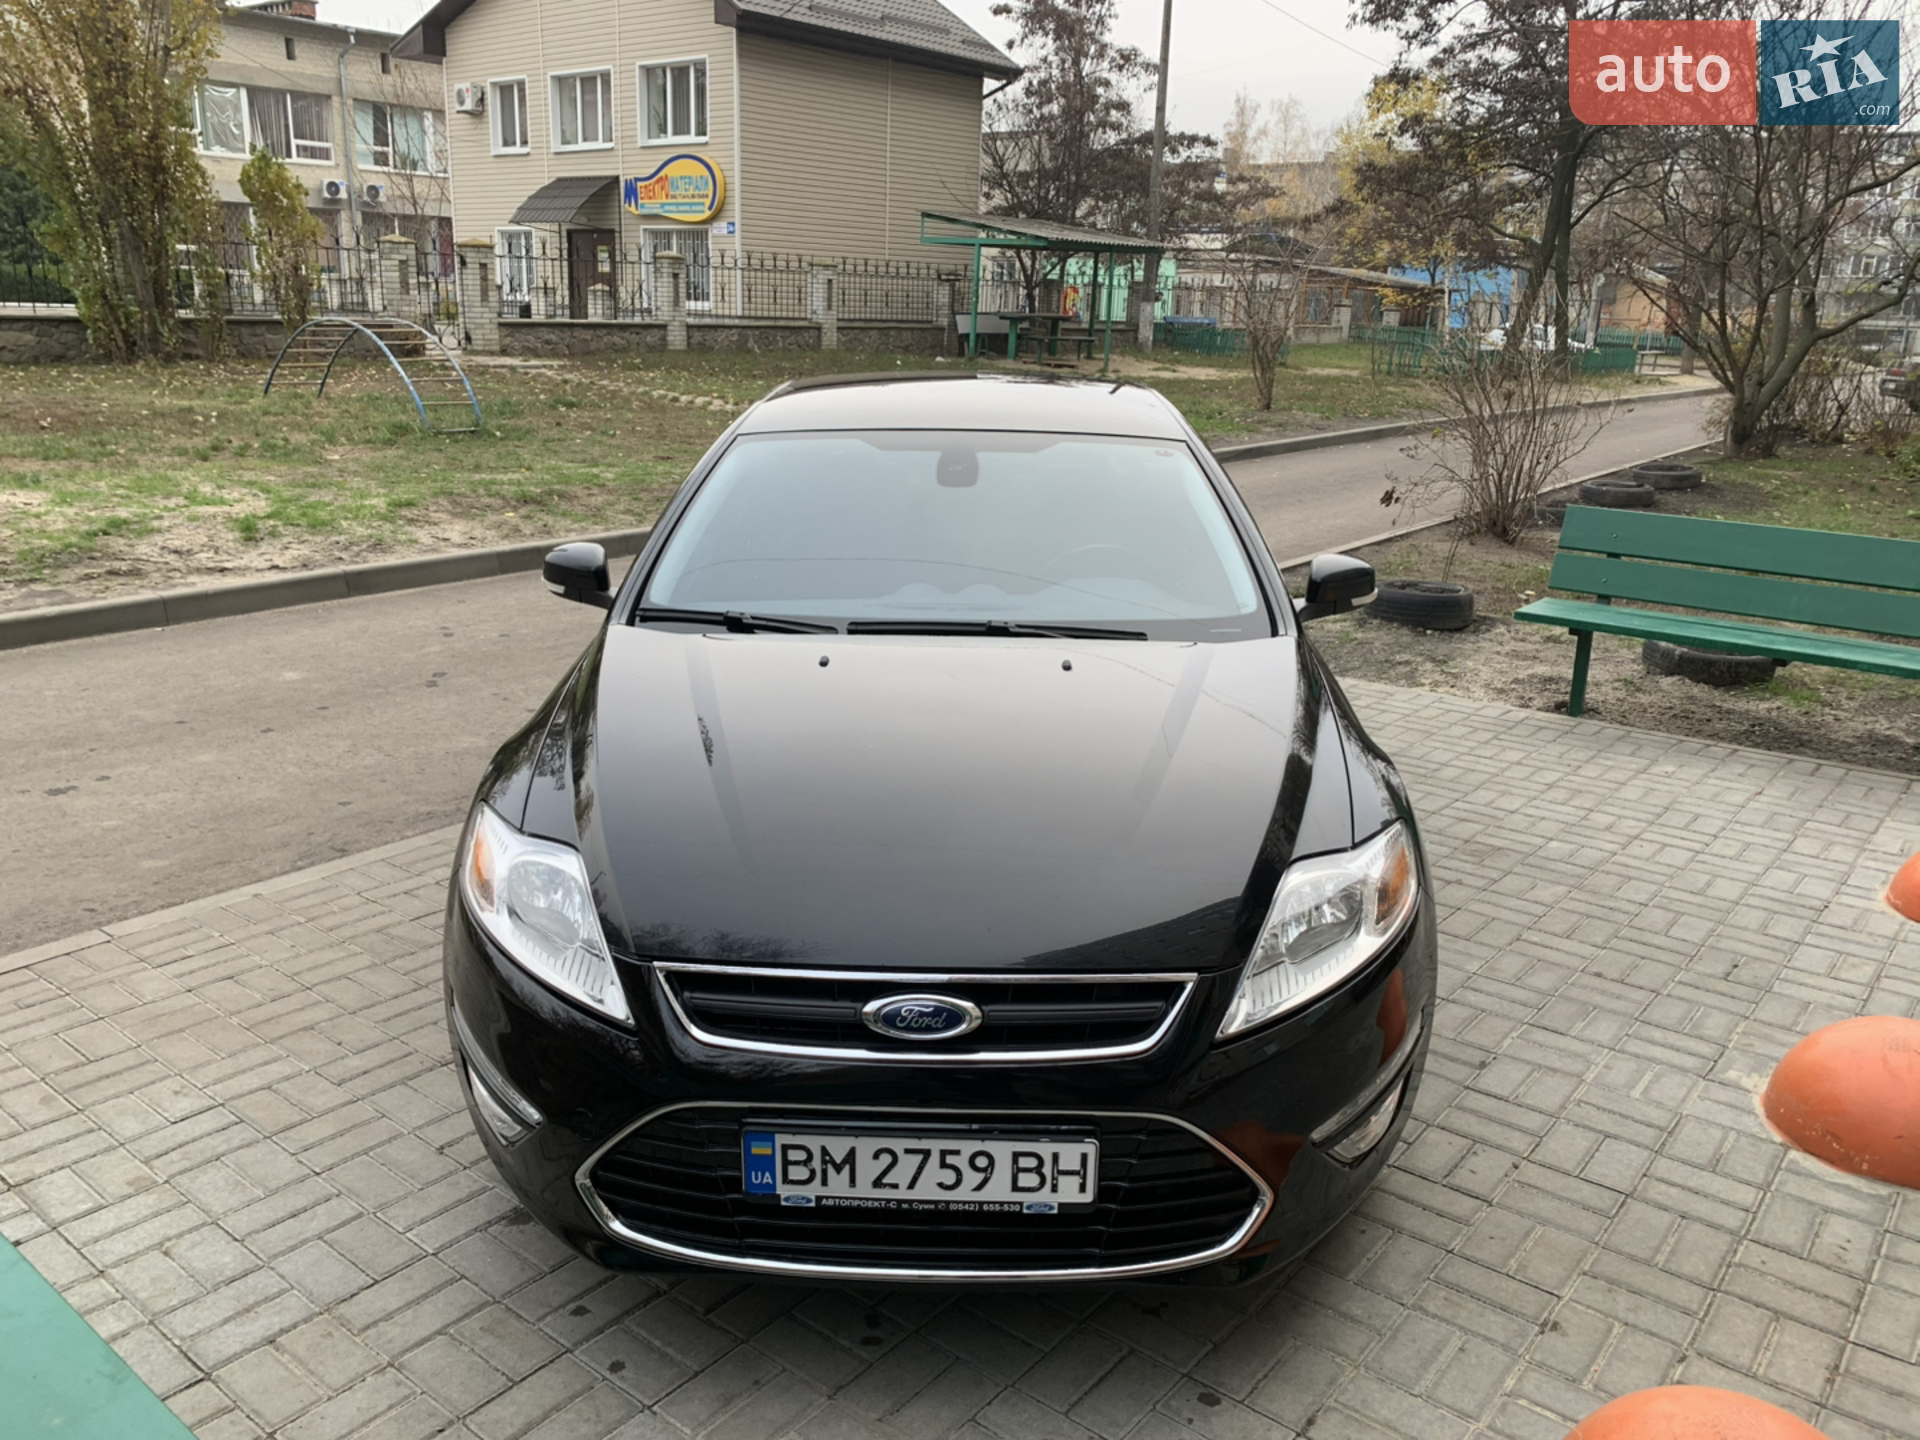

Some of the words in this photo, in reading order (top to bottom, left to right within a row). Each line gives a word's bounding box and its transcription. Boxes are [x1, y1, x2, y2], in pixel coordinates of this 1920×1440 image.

[896, 1006, 948, 1028] Ford
[751, 1170, 774, 1185] UA
[780, 1143, 858, 1189] BM
[871, 1147, 997, 1192] 2759
[1011, 1151, 1088, 1194] BH
[821, 1198, 898, 1209] АВТОПРОЕКТ-С
[948, 1203, 980, 1212] (0542)
[982, 1204, 1021, 1212] 655-530
